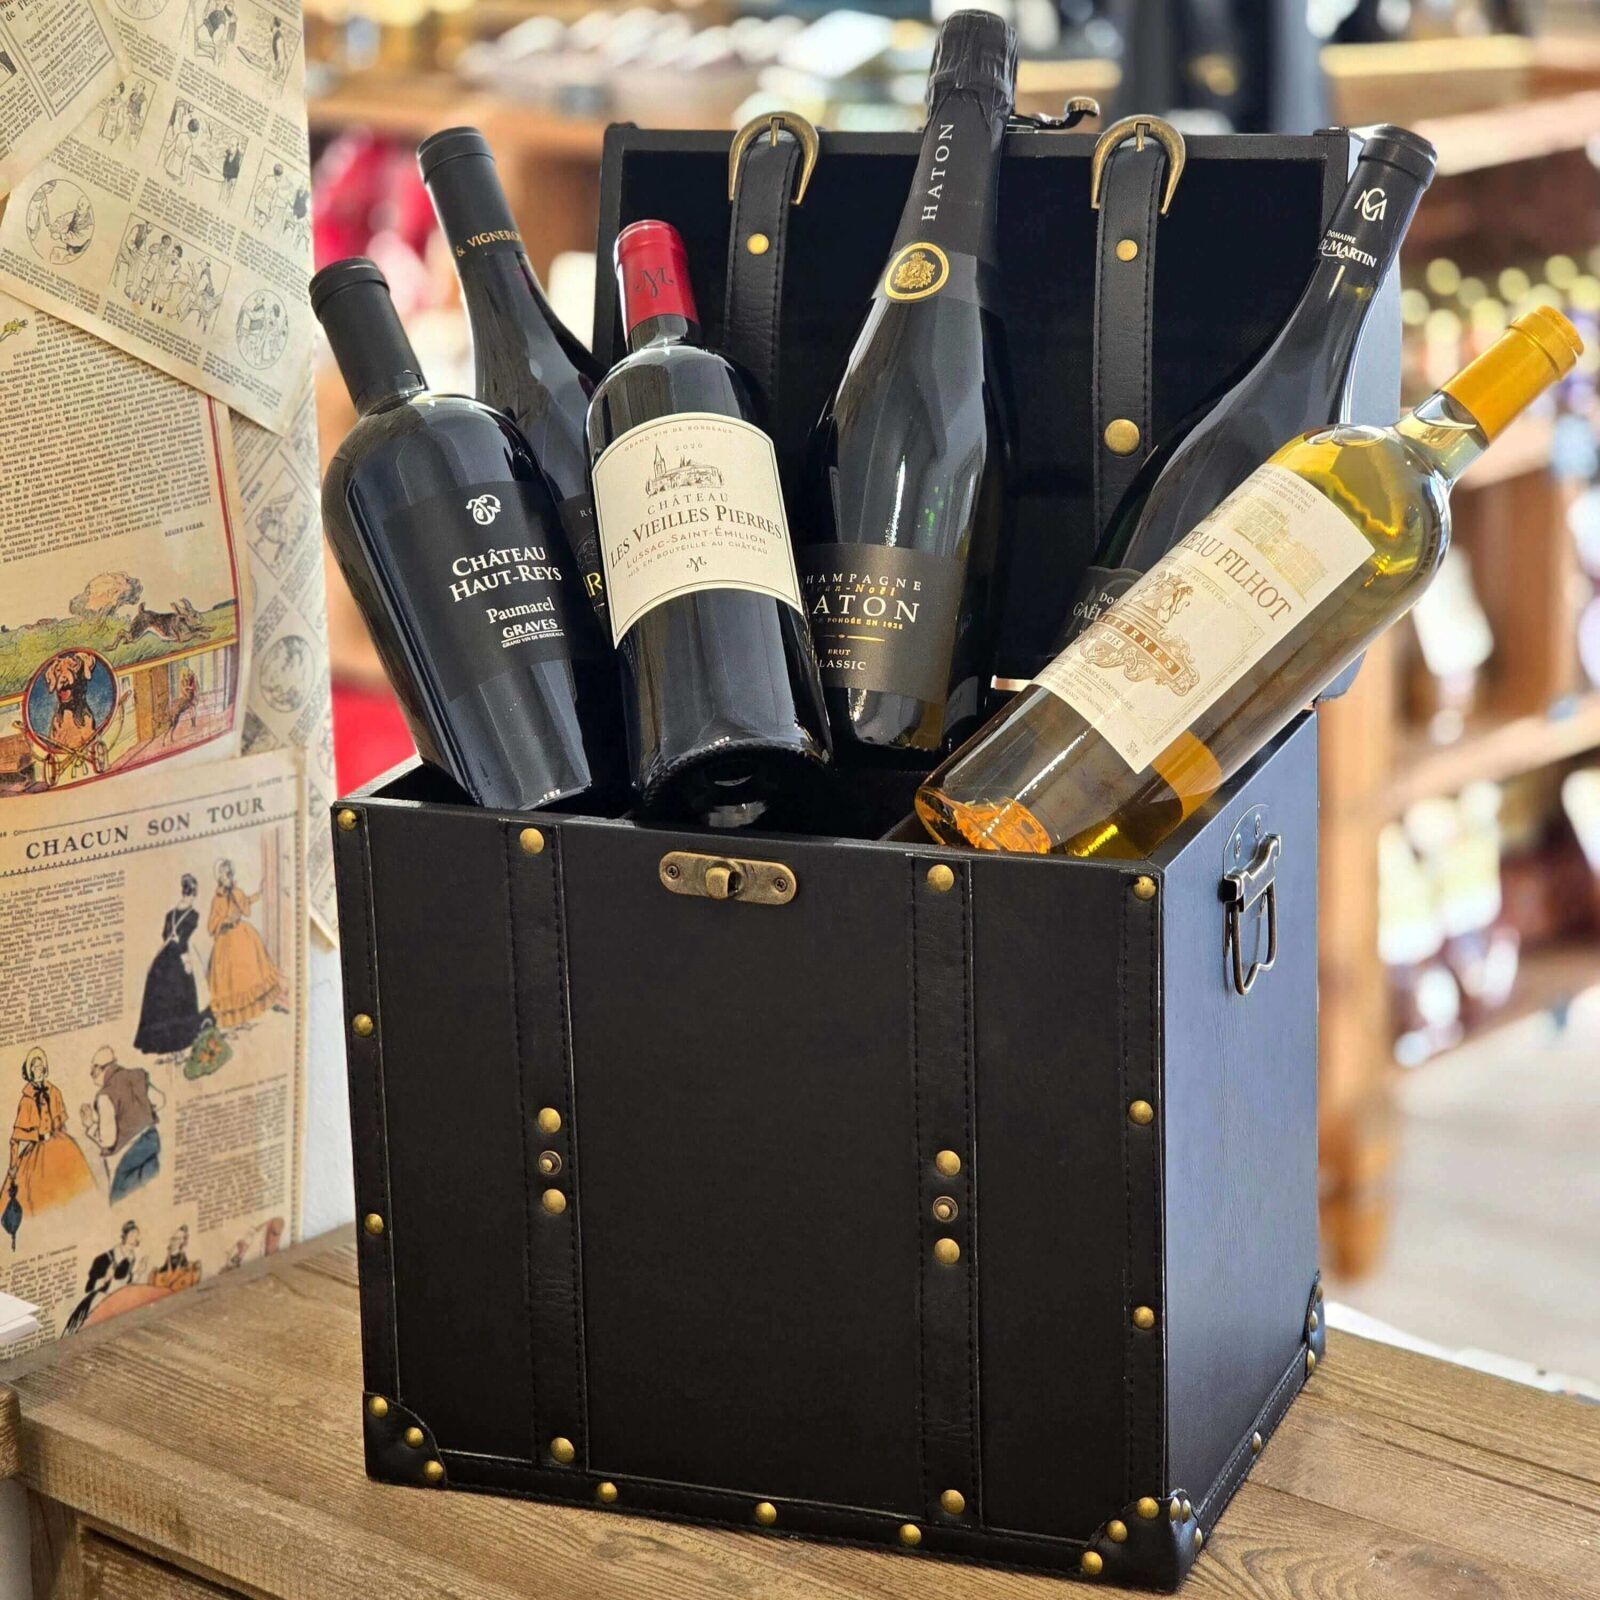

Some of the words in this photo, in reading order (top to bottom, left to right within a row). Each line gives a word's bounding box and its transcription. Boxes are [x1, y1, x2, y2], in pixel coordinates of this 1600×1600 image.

[921, 124, 954, 221] HATON
[1326, 230, 1356, 244] DOMAINE
[1328, 240, 1377, 268] MARTIN
[675, 443, 703, 452] 2020
[647, 492, 729, 515] CHÂTEAU
[609, 537, 631, 569] LES
[632, 506, 709, 543] VIEILLES
[715, 504, 782, 539] PIERRES
[626, 525, 766, 569] LUSSAC-SAINT-ÉMILION
[657, 541, 707, 558] BOUTEILLE
[728, 540, 768, 555] CHÂTEAU
[452, 547, 546, 576] CHÂTEAU
[449, 565, 562, 602] HAUT-REYS
[1214, 547, 1292, 622] FILHOT
[486, 597, 555, 624] Paumarel
[502, 618, 558, 639] GRAVES
[828, 648, 851, 656] BRUT
[26, 826, 129, 860] CHACUN
[147, 813, 191, 836] SON
[207, 797, 265, 824] TOUR
